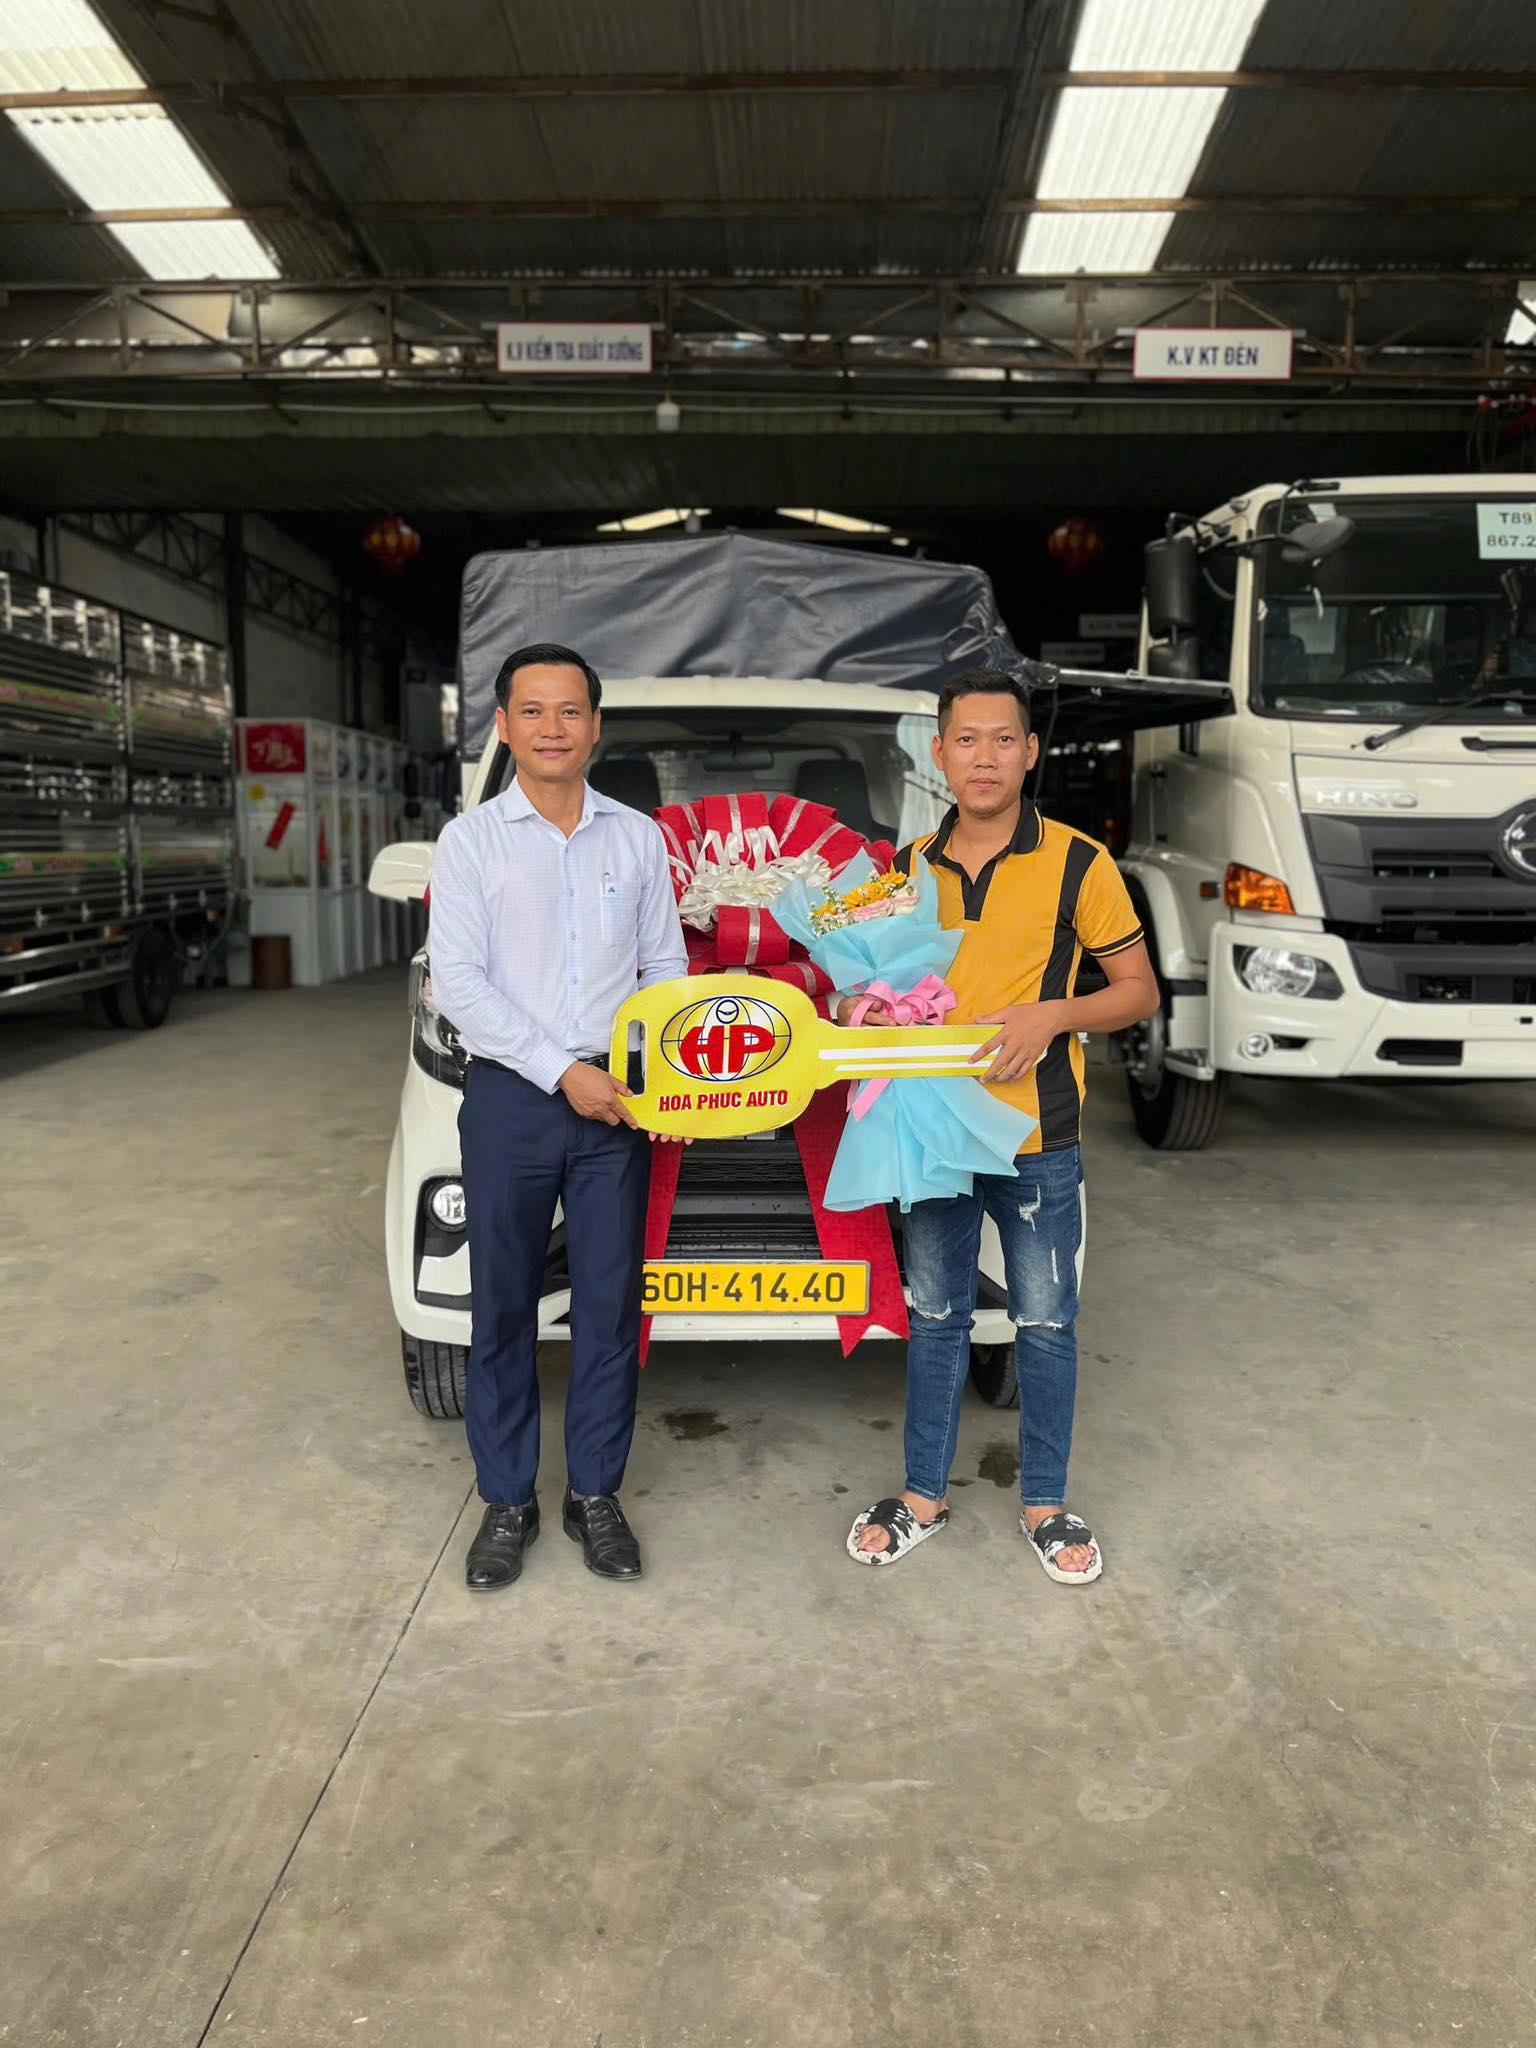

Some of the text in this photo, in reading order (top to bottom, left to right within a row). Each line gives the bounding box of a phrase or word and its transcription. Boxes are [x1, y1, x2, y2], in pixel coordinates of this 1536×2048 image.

[1167, 345, 1195, 366] K.V
[1199, 345, 1219, 366] KT
[1315, 789, 1419, 809] HINO
[678, 1024, 776, 1075] HP
[658, 1089, 789, 1113] HOA PHUC AUTO
[642, 1271, 846, 1303] 60H-414.40
